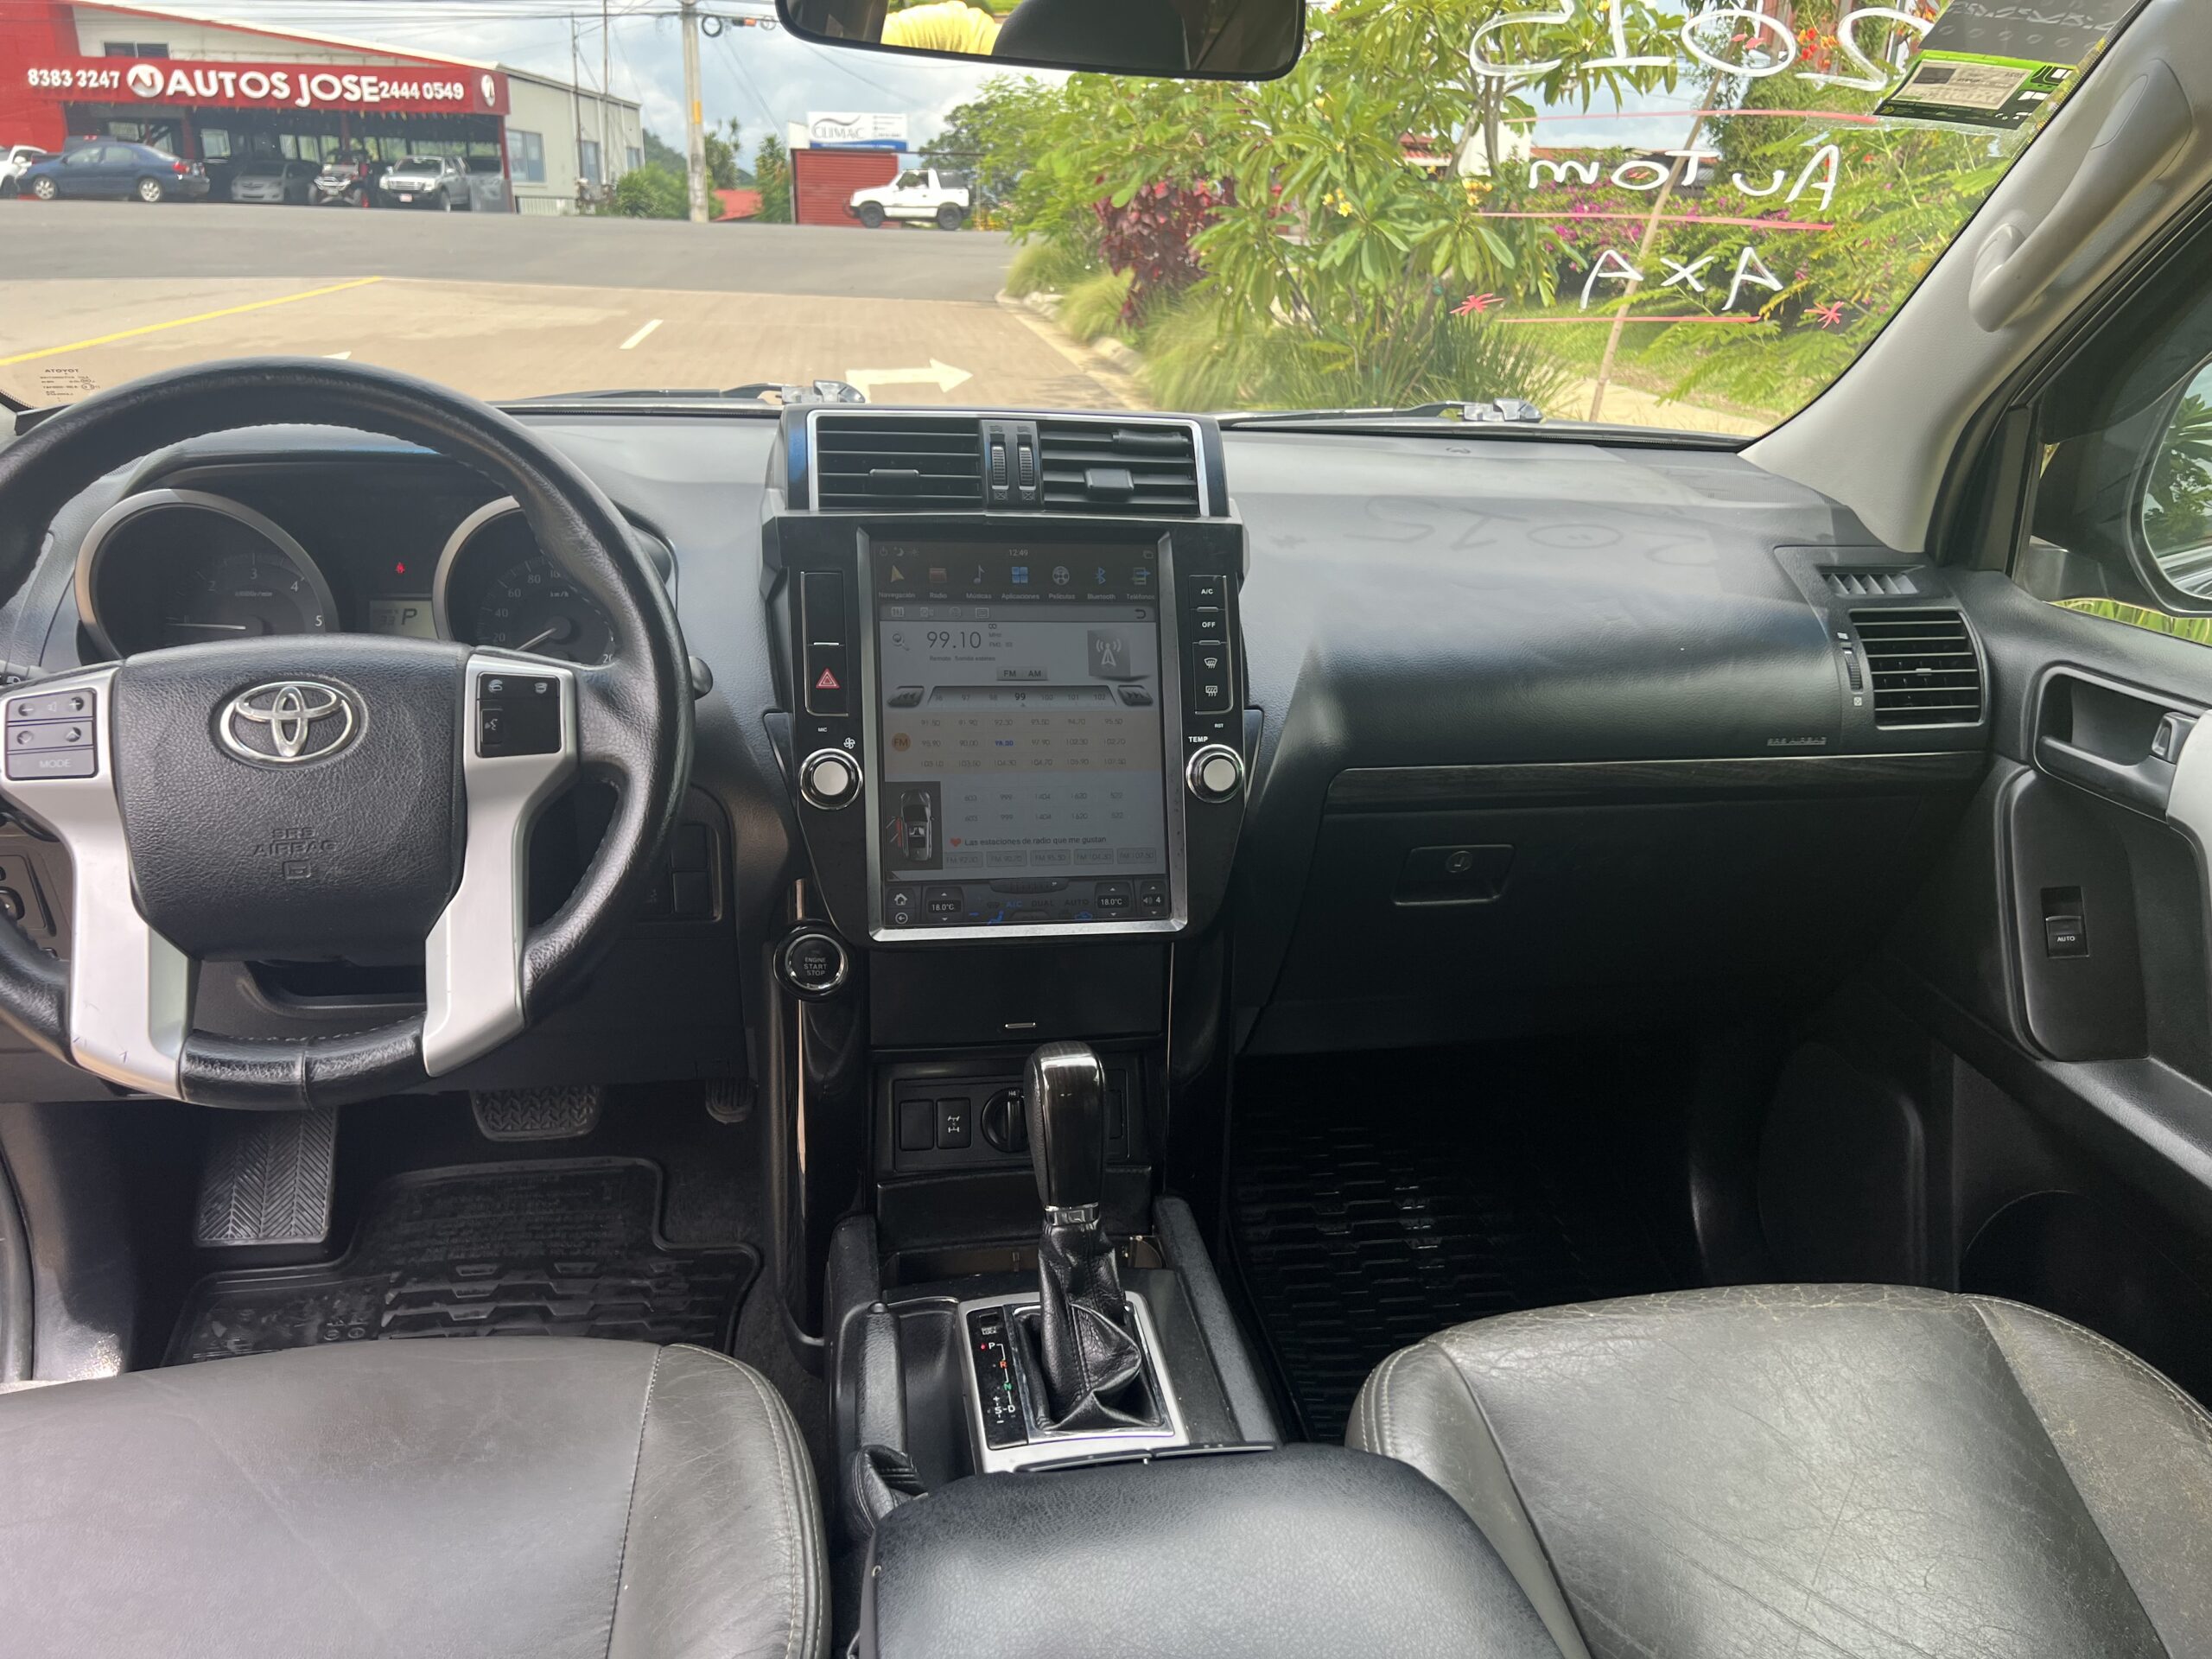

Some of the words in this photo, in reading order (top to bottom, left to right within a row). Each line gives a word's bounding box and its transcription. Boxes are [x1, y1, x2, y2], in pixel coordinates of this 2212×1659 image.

[28, 68, 73, 87] 8383
[75, 70, 119, 88] 3247
[166, 70, 290, 99] AUTOS
[296, 72, 380, 106] JOSE
[379, 80, 421, 99] 2444
[423, 81, 464, 100] 0549
[250, 569, 257, 580] 3
[527, 574, 541, 584] 80
[290, 581, 299, 592] 4
[508, 588, 522, 598] 60
[1001, 592, 1039, 601] Aplicaciones
[402, 607, 418, 626] P
[494, 608, 509, 619] 40
[315, 615, 322, 626] 5
[493, 633, 506, 644] 20
[926, 631, 982, 649] 99.10
[1014, 692, 1026, 701] 99
[893, 738, 908, 747] FM
[39, 758, 71, 769] MODE
[1082, 836, 1107, 845] gustan
[1000, 1360, 1007, 1369] R
